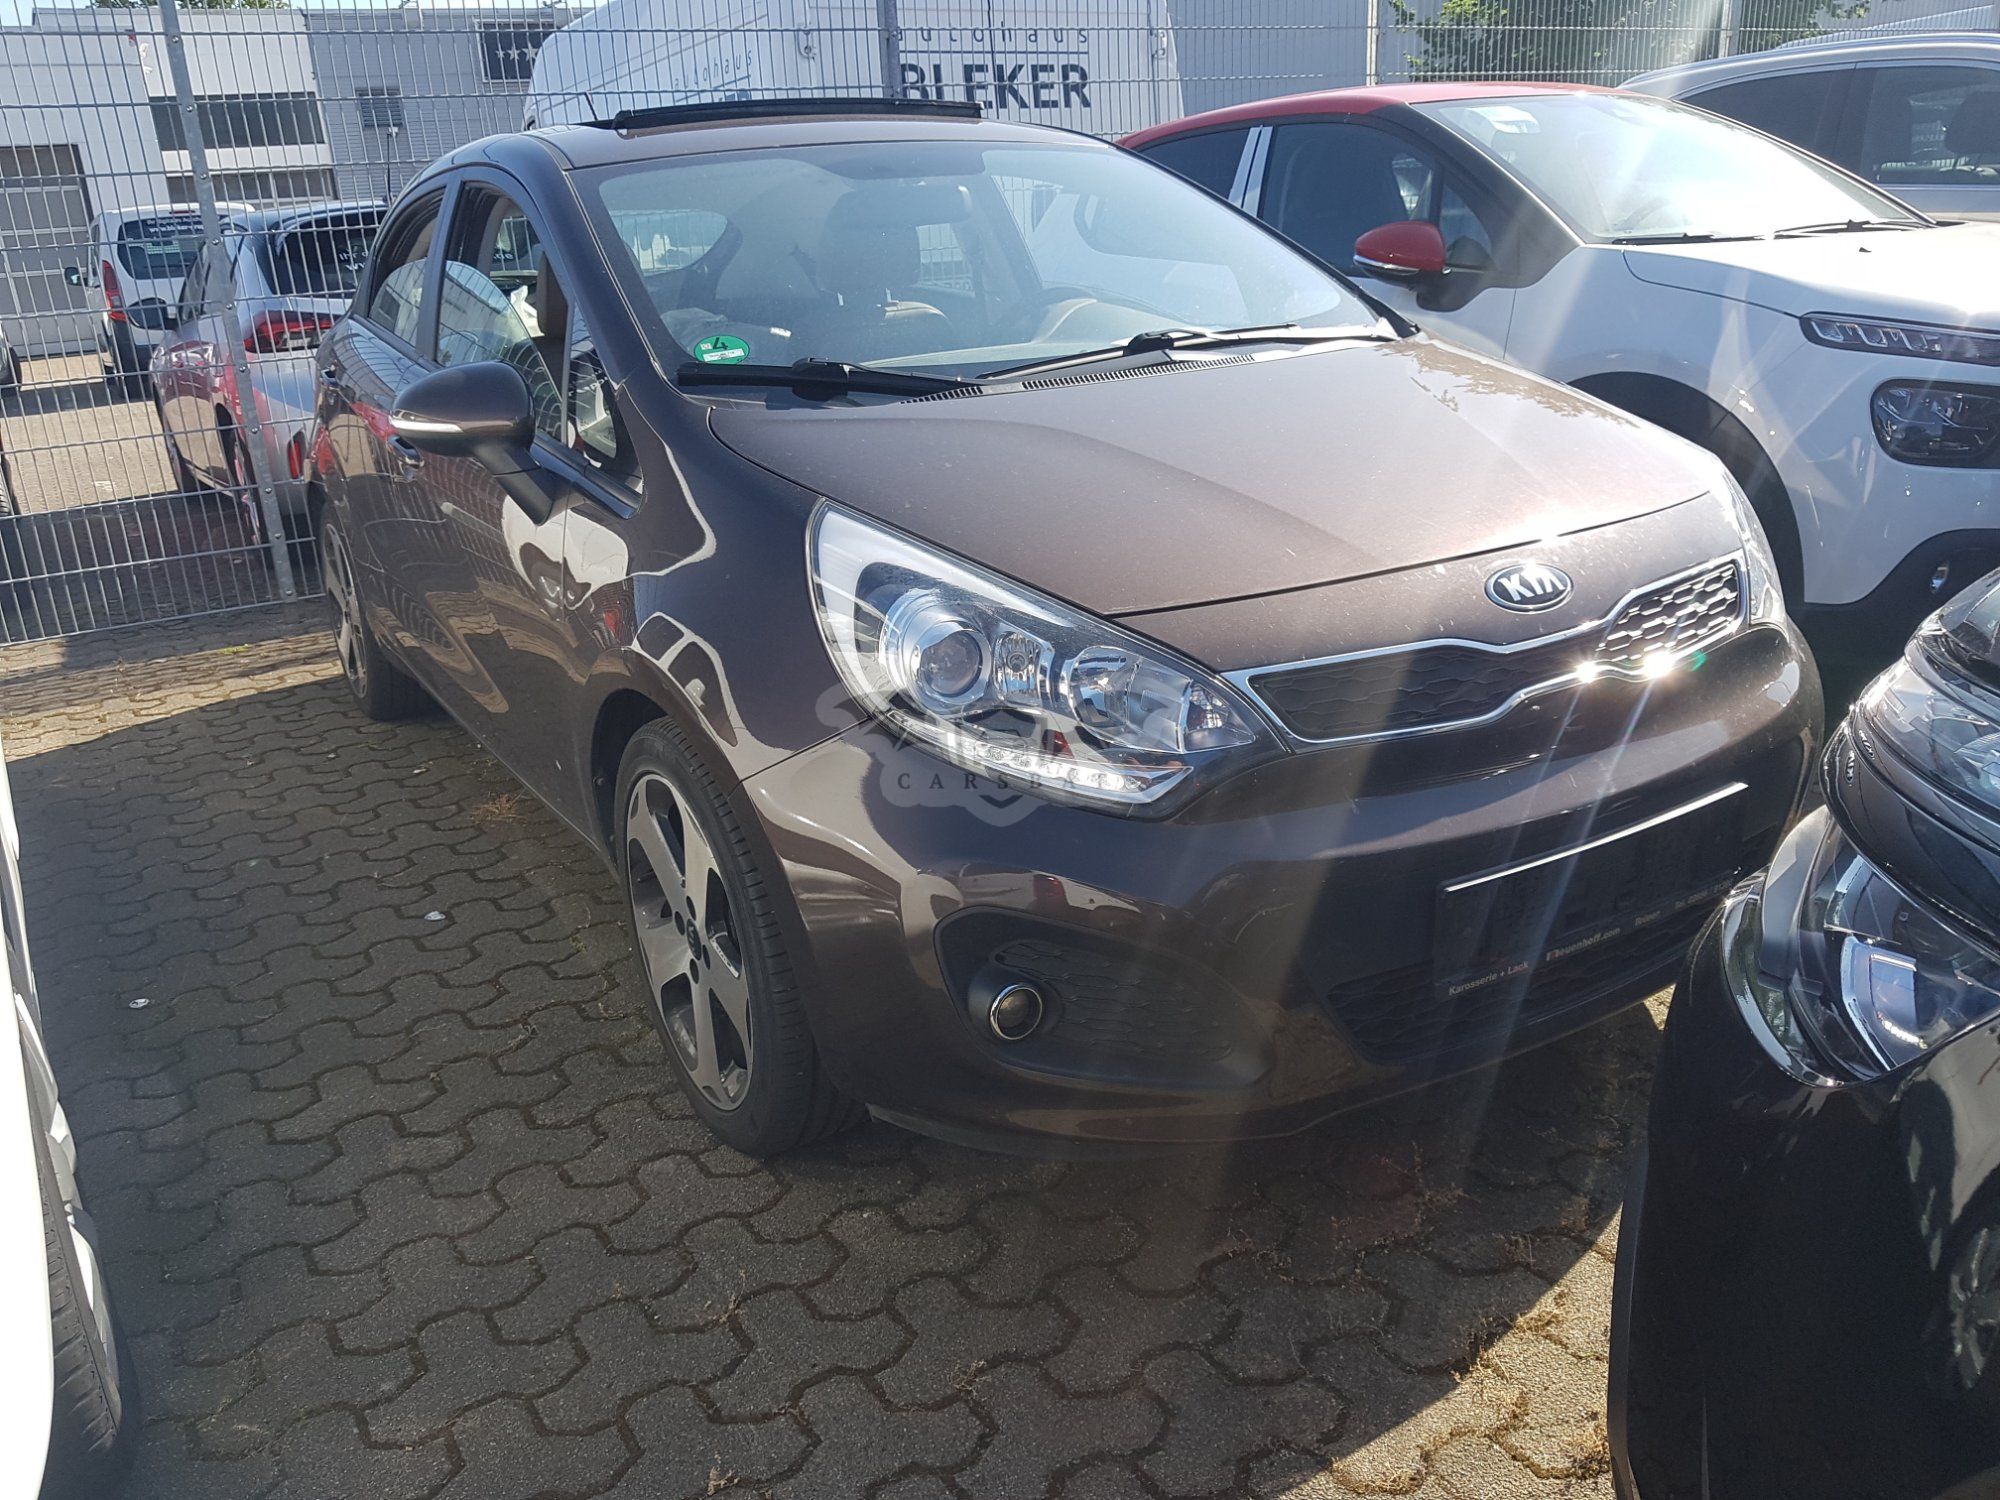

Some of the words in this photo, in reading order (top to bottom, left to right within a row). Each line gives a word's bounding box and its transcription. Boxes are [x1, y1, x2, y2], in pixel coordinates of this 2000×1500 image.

[713, 337, 728, 350] 4
[1498, 567, 1566, 602] KIA
[1448, 972, 1498, 996] Karosserie
